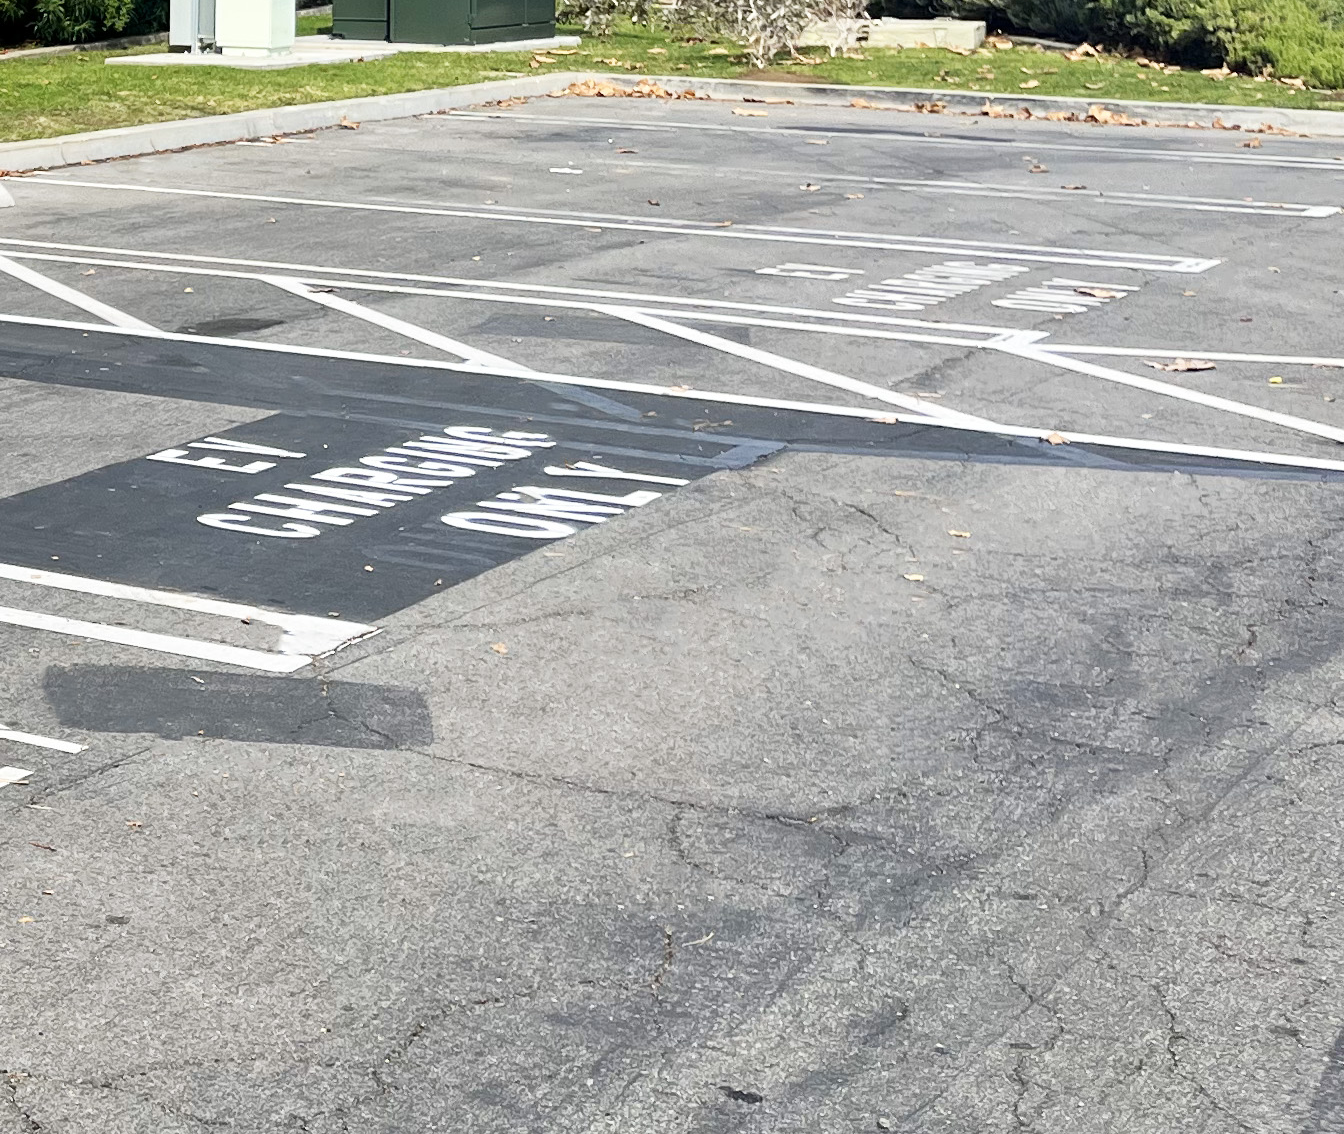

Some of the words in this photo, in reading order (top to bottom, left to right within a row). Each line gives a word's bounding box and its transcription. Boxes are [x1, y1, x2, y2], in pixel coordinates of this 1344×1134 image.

[145, 436, 307, 474] EV
[196, 426, 557, 538] CHARGING
[441, 461, 691, 539] ONLY
